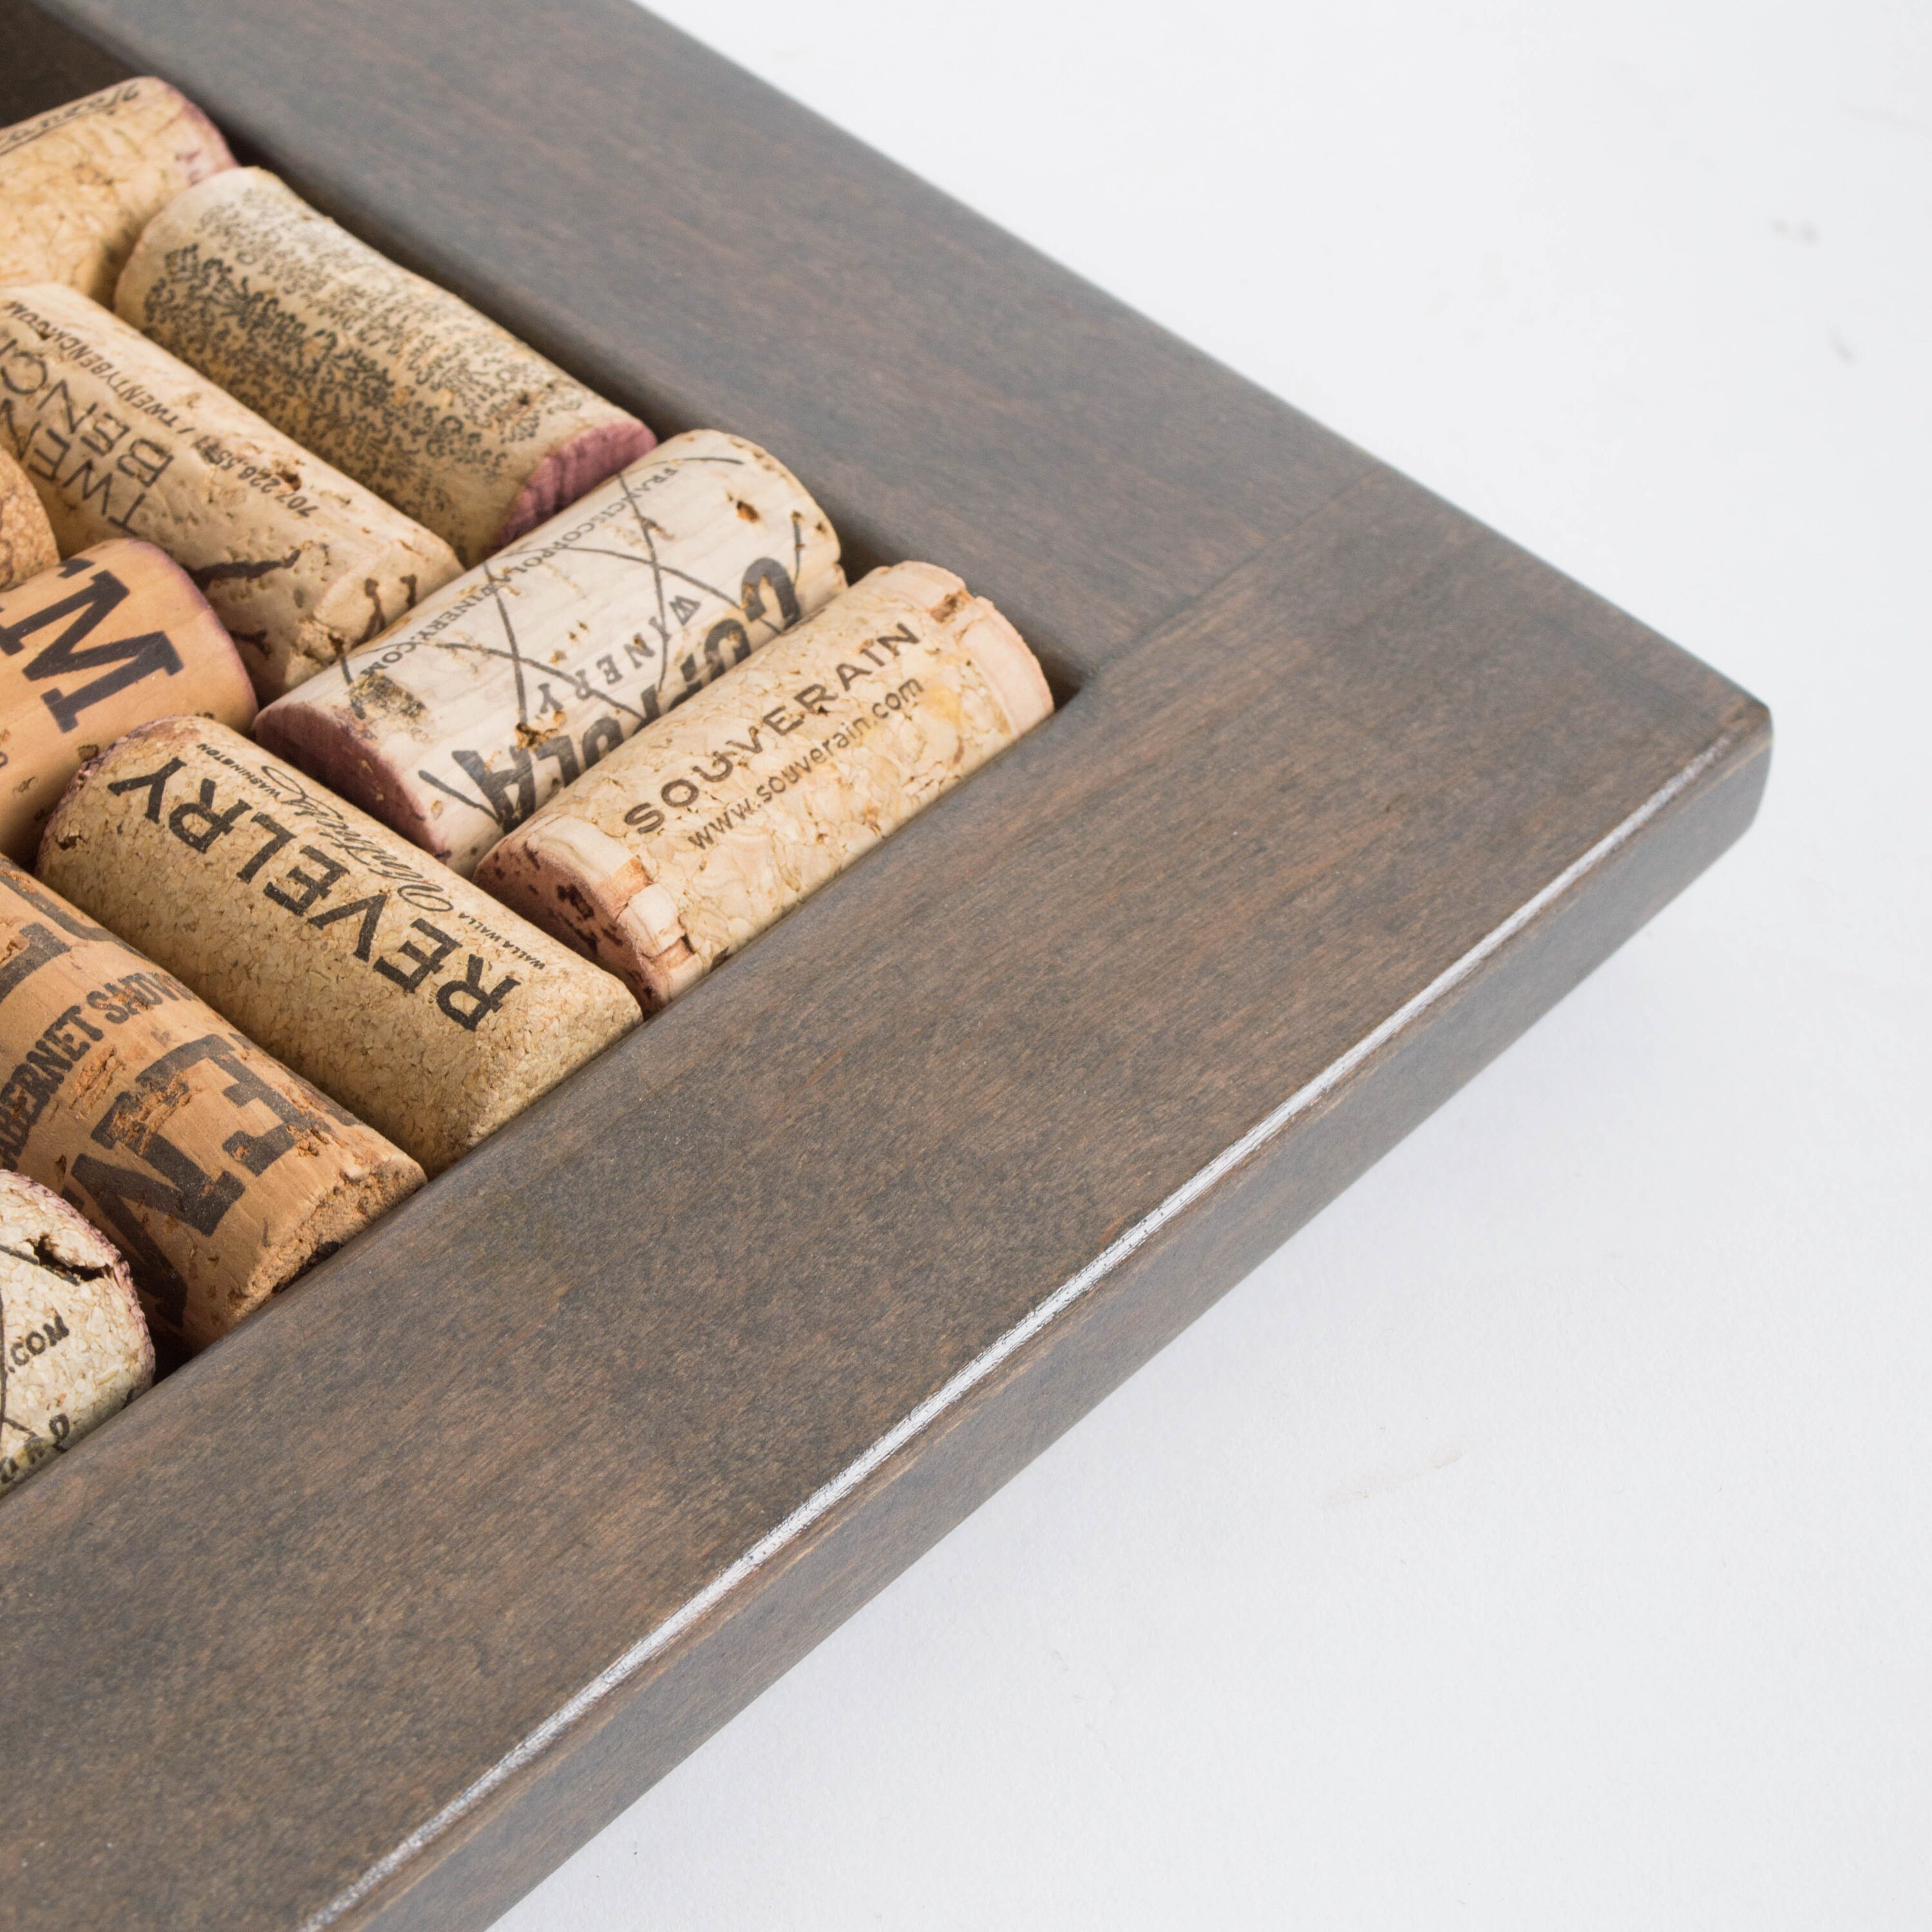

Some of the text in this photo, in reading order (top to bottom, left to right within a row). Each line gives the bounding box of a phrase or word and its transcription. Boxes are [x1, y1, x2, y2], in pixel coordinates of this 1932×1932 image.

[537, 595, 701, 714] WINERY
[624, 623, 921, 835] SOUVERAIN
[196, 743, 545, 970] WALLA WALLA Vintners WASHINGTON
[688, 674, 925, 850] www.souverain.com
[108, 757, 521, 1032] REVELRY
